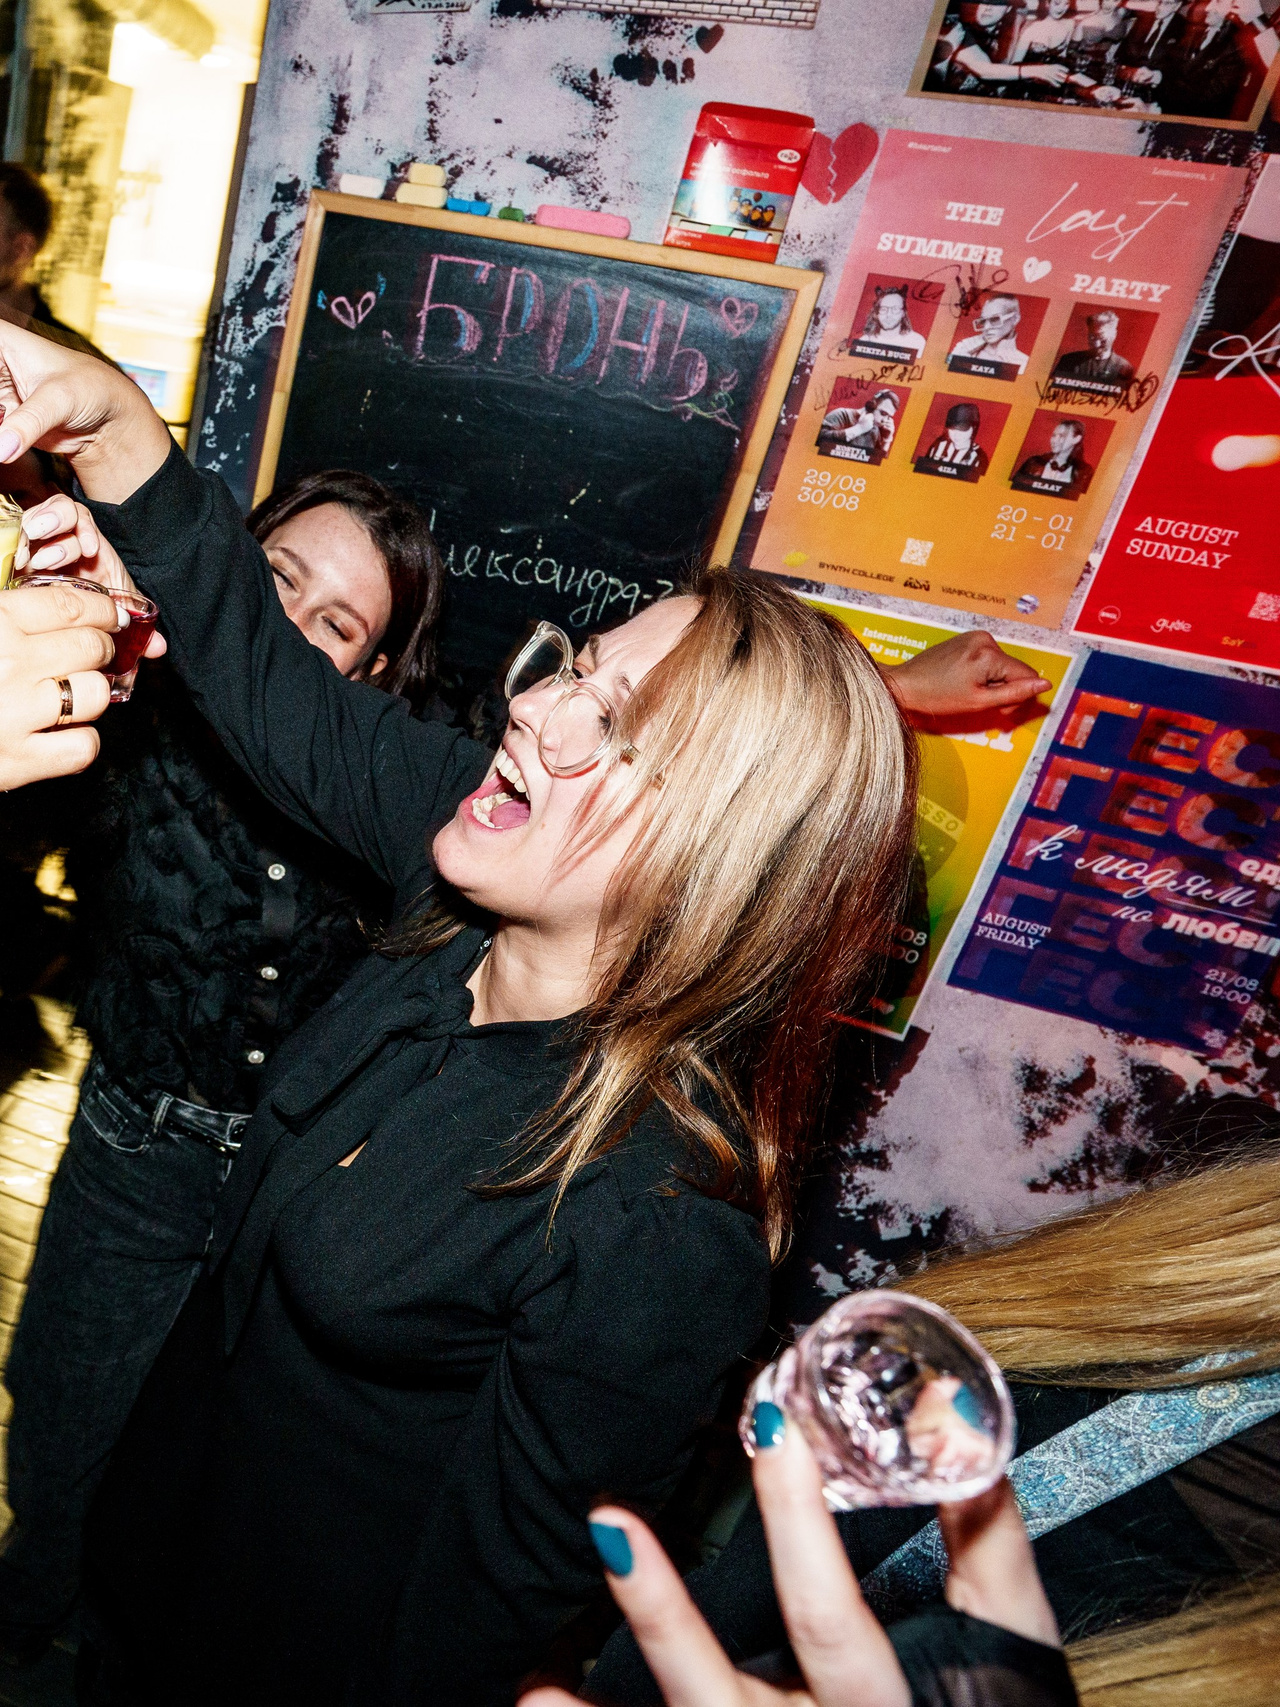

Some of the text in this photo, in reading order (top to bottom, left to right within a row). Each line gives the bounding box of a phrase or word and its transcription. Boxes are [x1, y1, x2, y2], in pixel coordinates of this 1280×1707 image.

[945, 201, 1005, 227] THE
[877, 232, 1171, 303] SUMMER PARTY
[416, 253, 710, 402] БРОНЬ
[803, 468, 867, 494] 29/08
[797, 486, 860, 512] 30/08
[1134, 515, 1239, 547] AUGUST
[1125, 538, 1232, 570] SUNDAY
[862, 627, 927, 650] International
[884, 647, 900, 658] set
[975, 924, 1042, 950] FRIDAY
[980, 912, 1051, 938] AUGUST
[1204, 968, 1259, 992] 21/08
[1200, 983, 1252, 1006] 19:00
